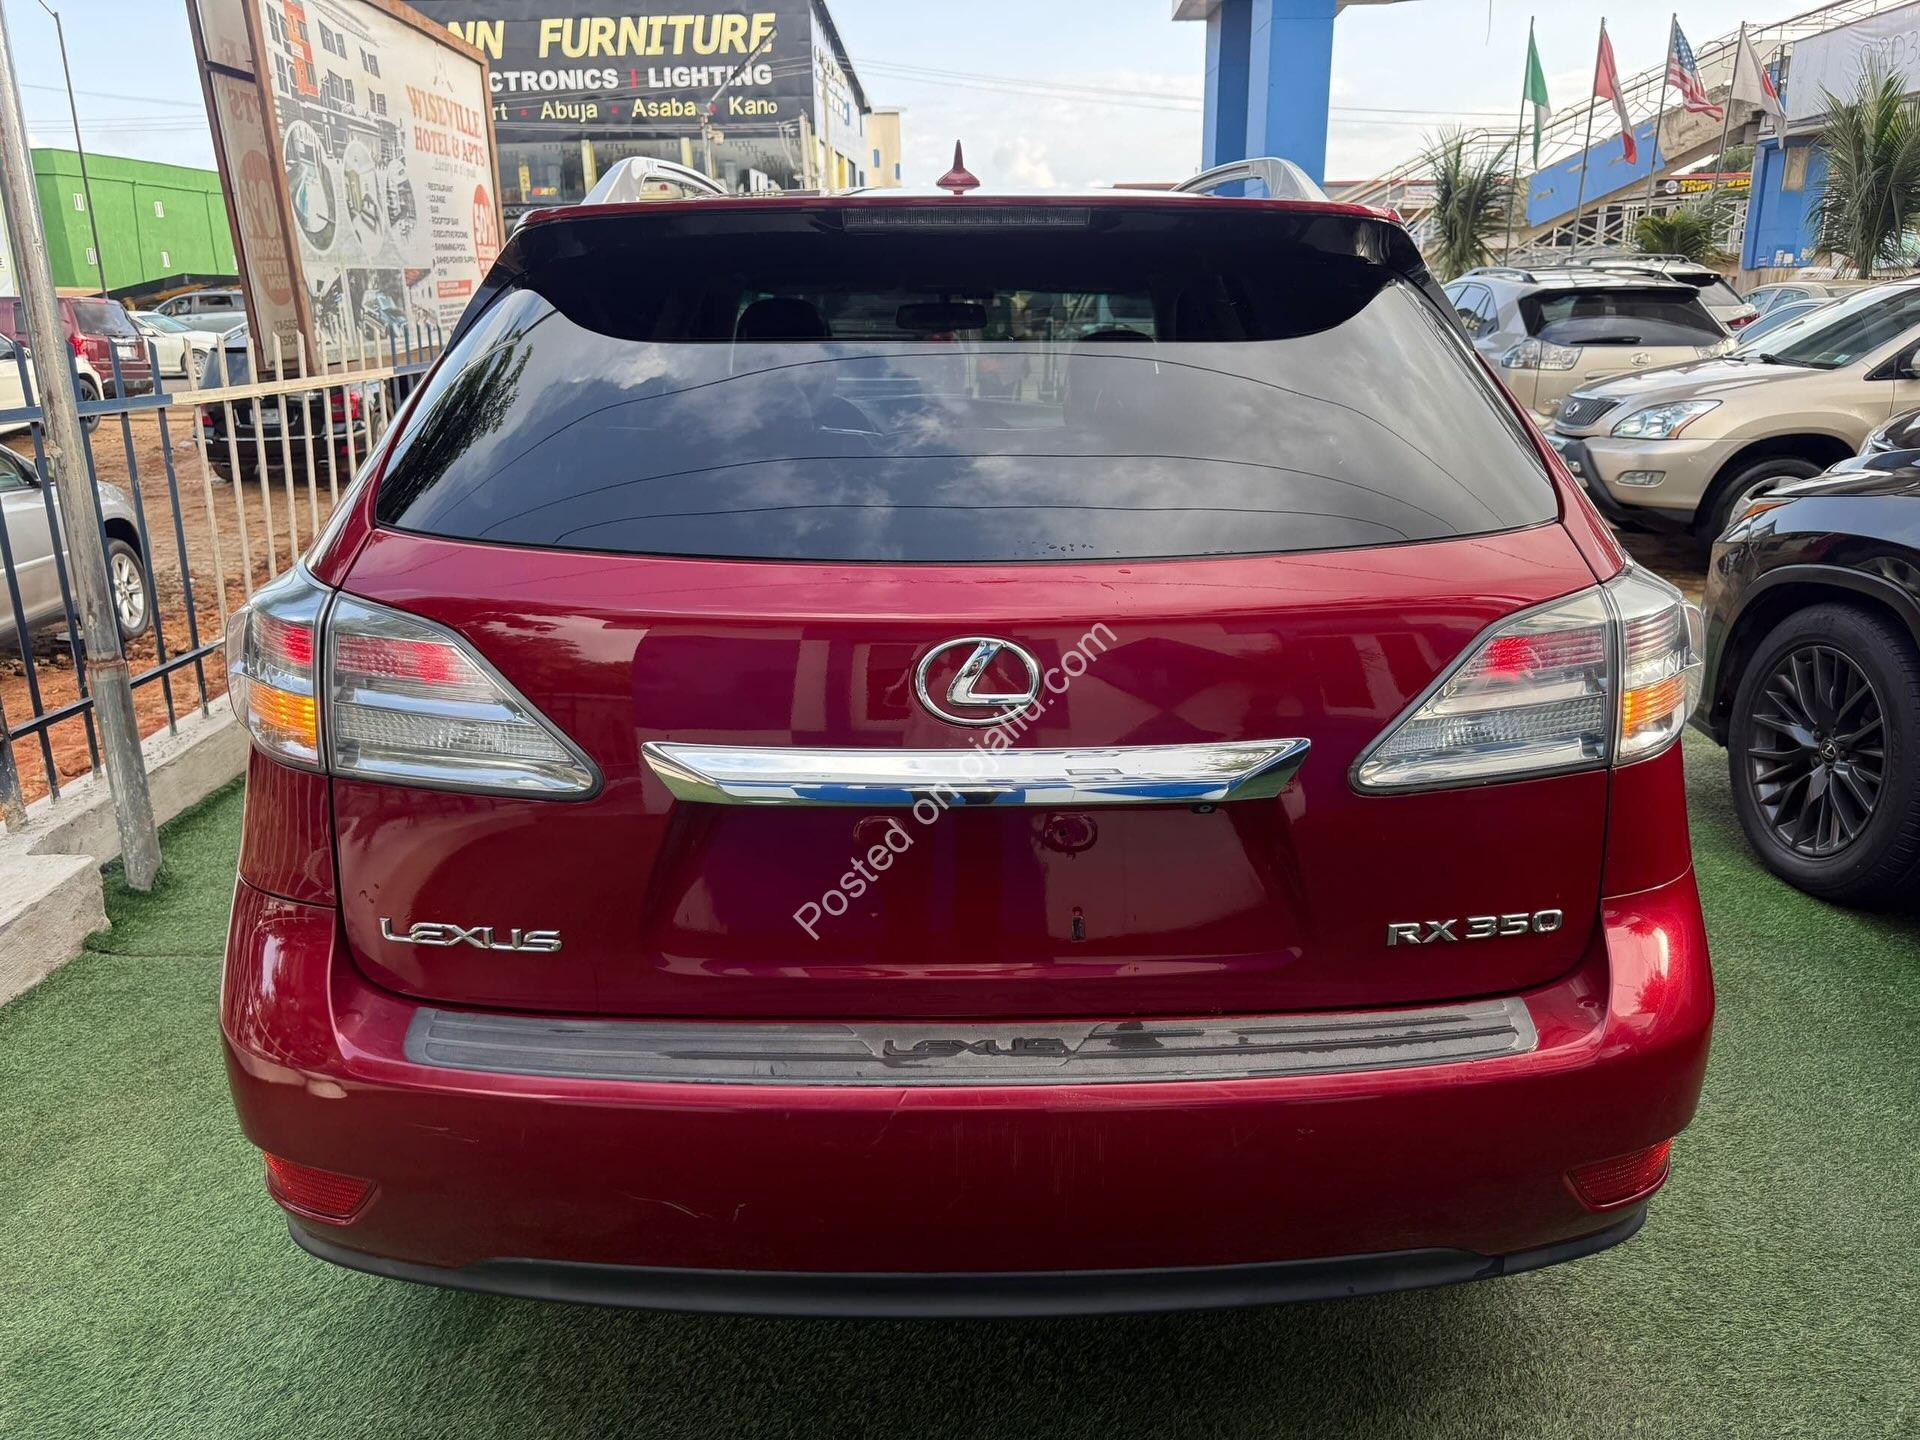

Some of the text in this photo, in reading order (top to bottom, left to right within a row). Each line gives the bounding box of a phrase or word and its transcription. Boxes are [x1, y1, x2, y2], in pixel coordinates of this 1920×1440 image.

[539, 13, 777, 58] FURNITURE
[648, 64, 773, 89] LIGHTING
[406, 84, 481, 139] WISEVILLE
[540, 100, 598, 122] Abuja
[631, 98, 697, 120] Asaba
[728, 97, 778, 117] Kano
[414, 125, 450, 157] HOTEL
[462, 140, 485, 167] APTS
[379, 917, 562, 951] LEXUS
[1386, 908, 1563, 946] RX 350
[882, 1037, 1077, 1058] LEXUS
